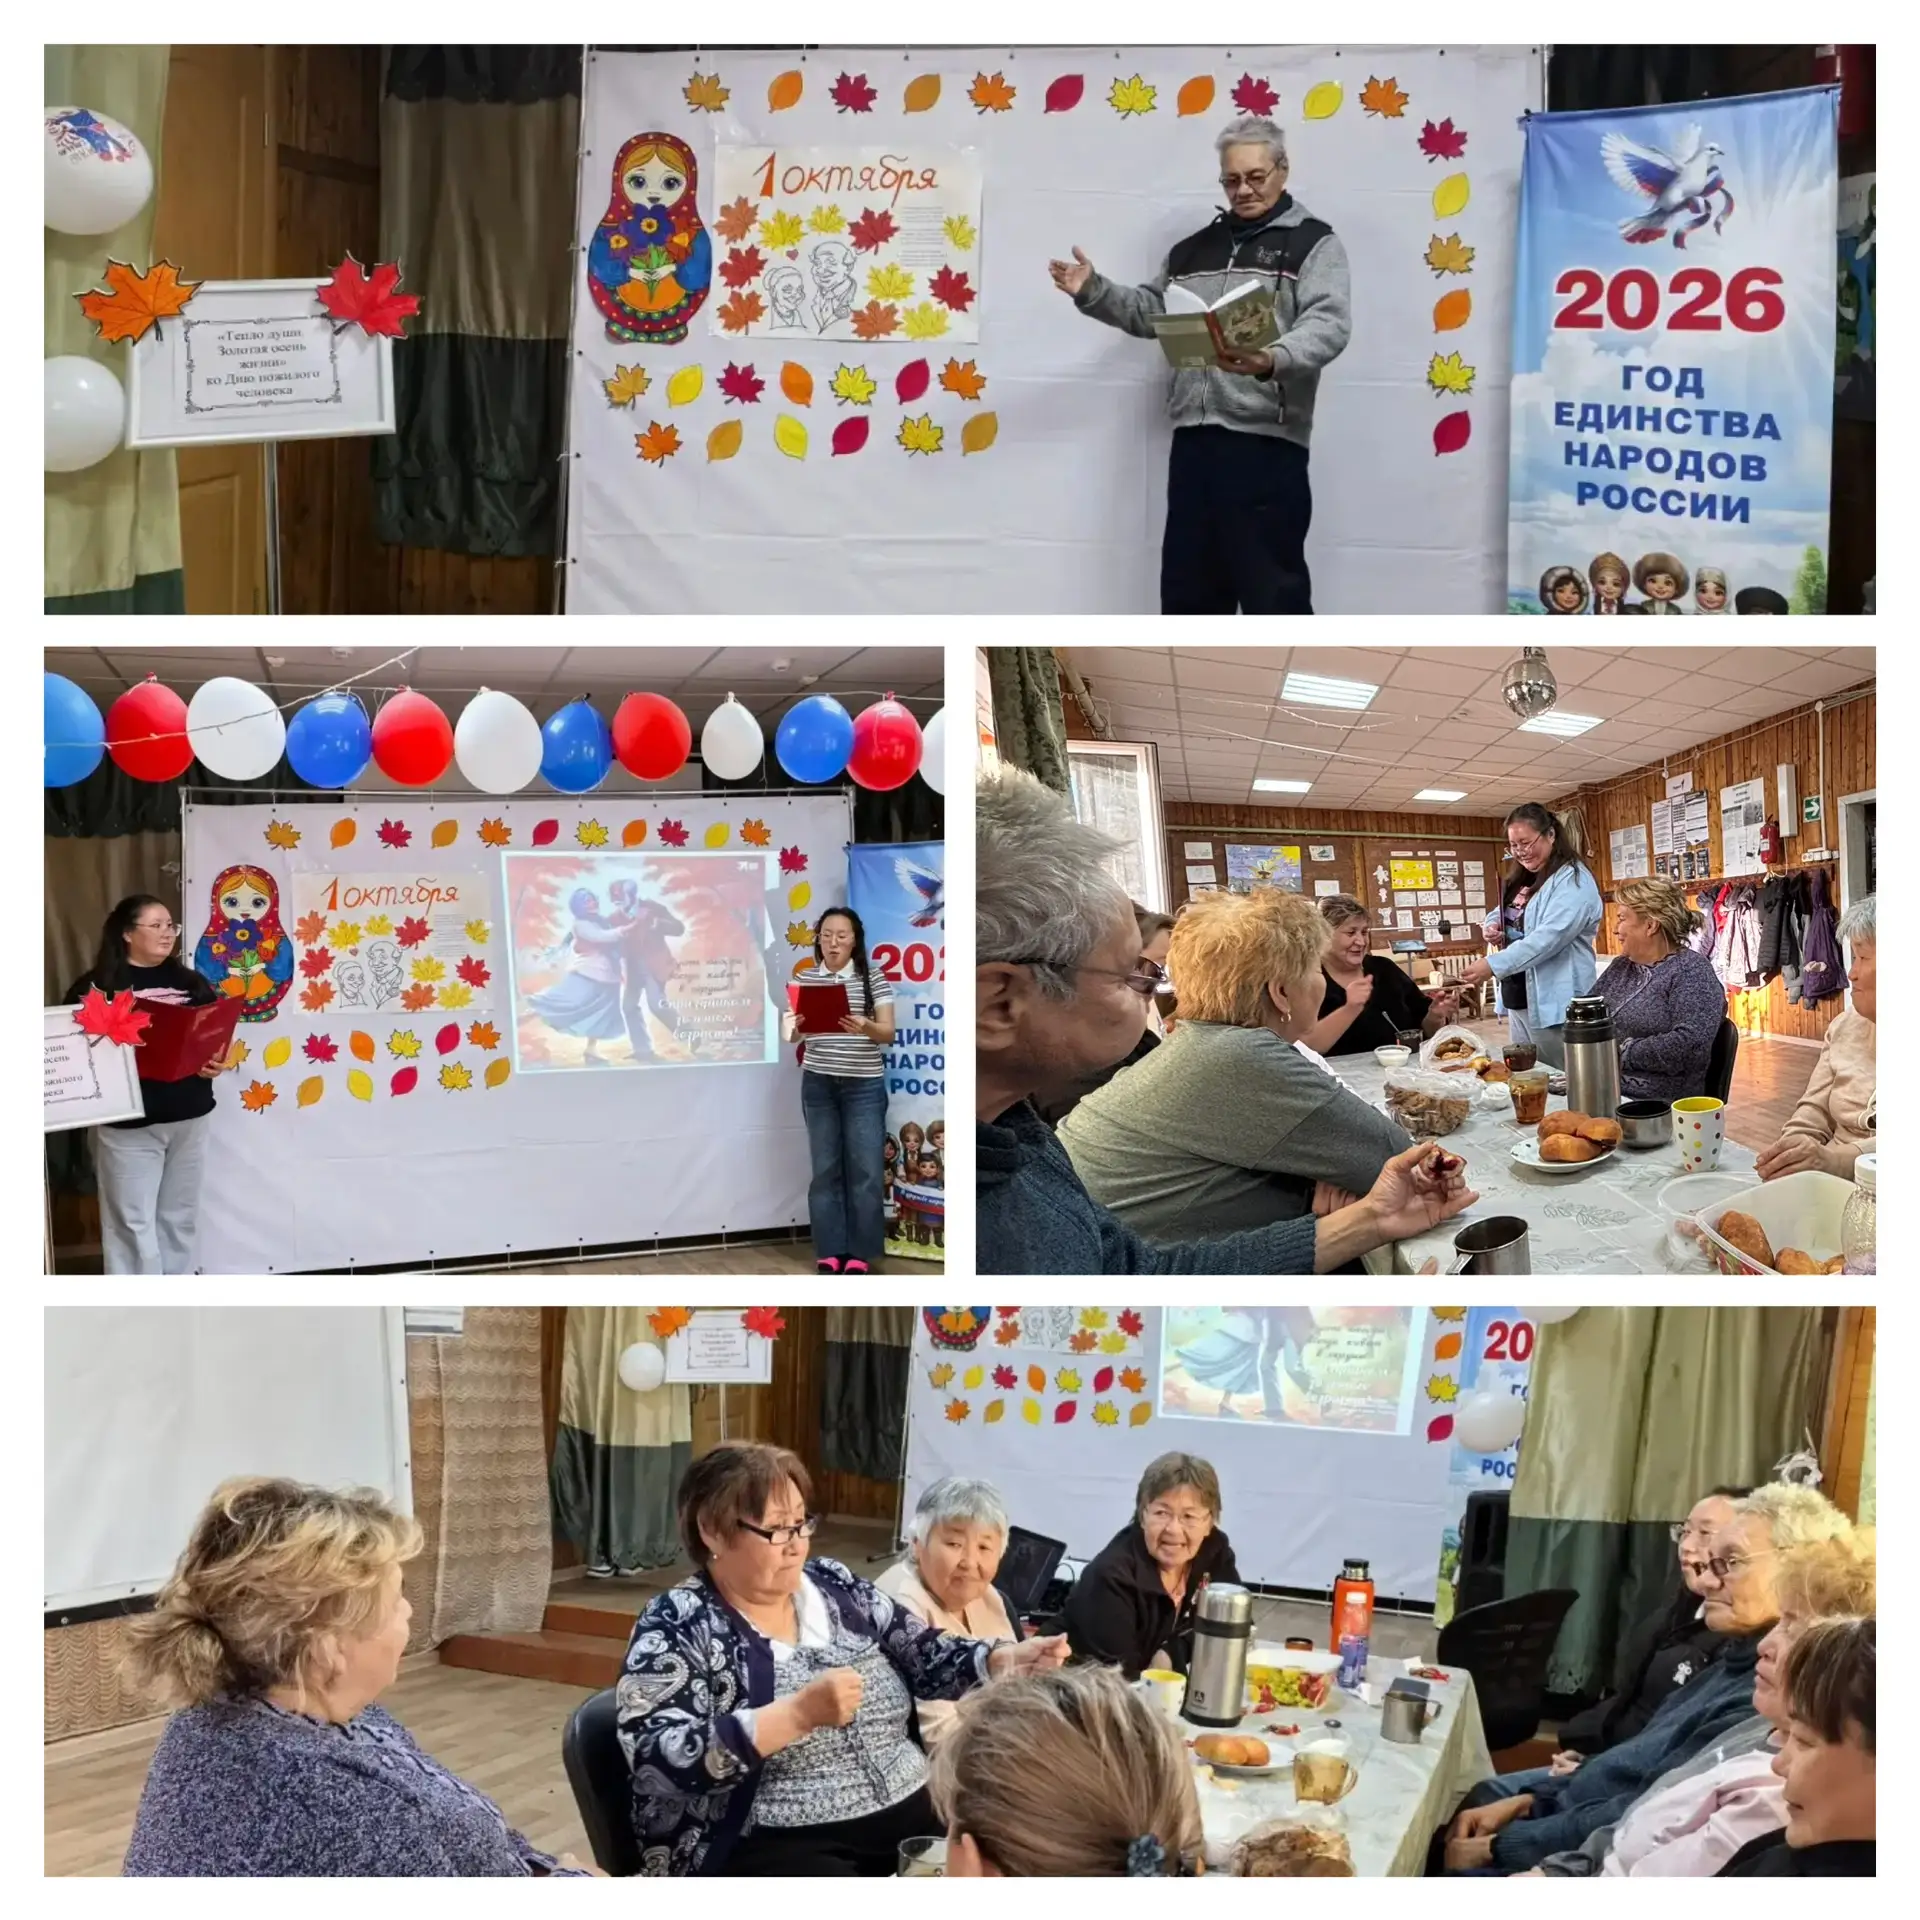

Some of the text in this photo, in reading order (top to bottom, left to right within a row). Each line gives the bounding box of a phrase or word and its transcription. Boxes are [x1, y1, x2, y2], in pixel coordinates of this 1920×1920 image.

[753, 151, 939, 208] 1 октября
[1554, 267, 1786, 332] 2026
[218, 343, 307, 356] Золотая осень
[206, 370, 321, 386] ко Дню пожилого
[235, 386, 293, 398] человека
[1622, 365, 1705, 399] ГОД
[1554, 402, 1782, 441] ЕДИНСТВА
[1564, 441, 1767, 483] НАРОДОВ
[1577, 481, 1750, 524] РОССИИ
[320, 877, 460, 916] 1 октября
[872, 943, 945, 982] 20
[889, 1028, 945, 1048] ДИН
[890, 1077, 945, 1096] РОС
